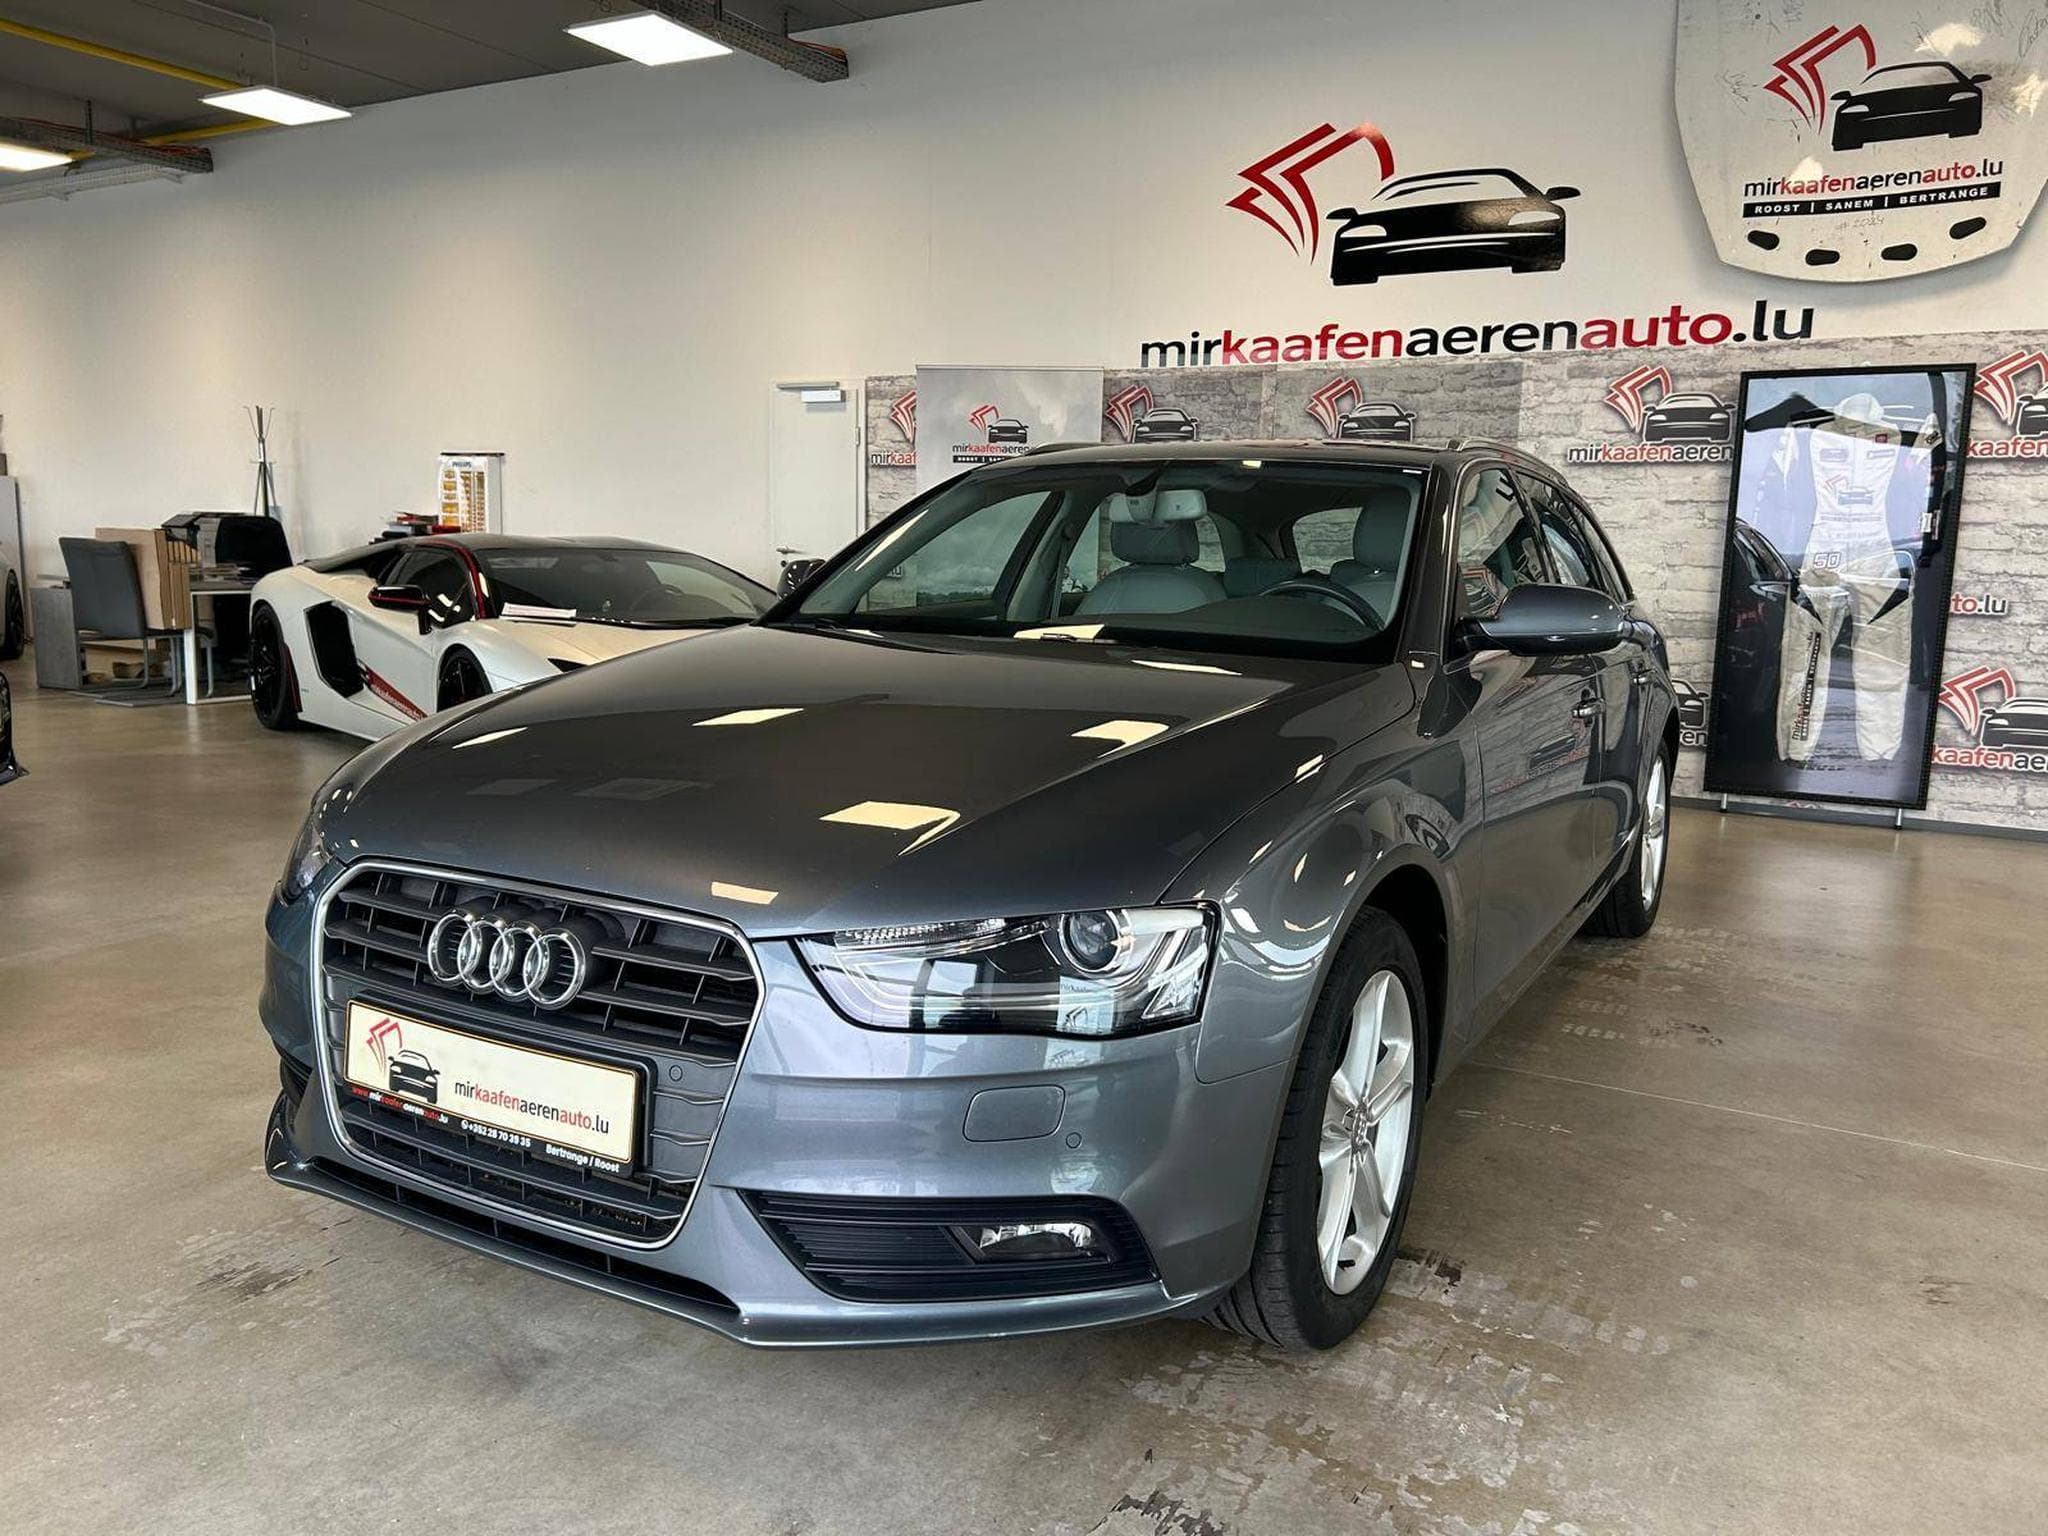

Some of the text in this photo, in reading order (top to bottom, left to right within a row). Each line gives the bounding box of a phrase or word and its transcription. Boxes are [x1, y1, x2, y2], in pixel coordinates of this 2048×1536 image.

[1744, 158, 2004, 197] mirkaafenaerenauto.lu
[1754, 203, 1801, 214] ROOST
[1825, 199, 1874, 212] SANEM
[1899, 186, 1989, 205] BERTRANGE
[1141, 300, 1814, 367] mirkaafenaerenauto.lu
[1569, 443, 1733, 462] mirkaafenaeren
[1814, 551, 1841, 568] 50
[455, 1080, 609, 1134] mirkaafenaerenauto.lu
[498, 1130, 509, 1142] 70
[545, 1144, 588, 1166] Bertrange
[594, 1158, 620, 1173] Roost
